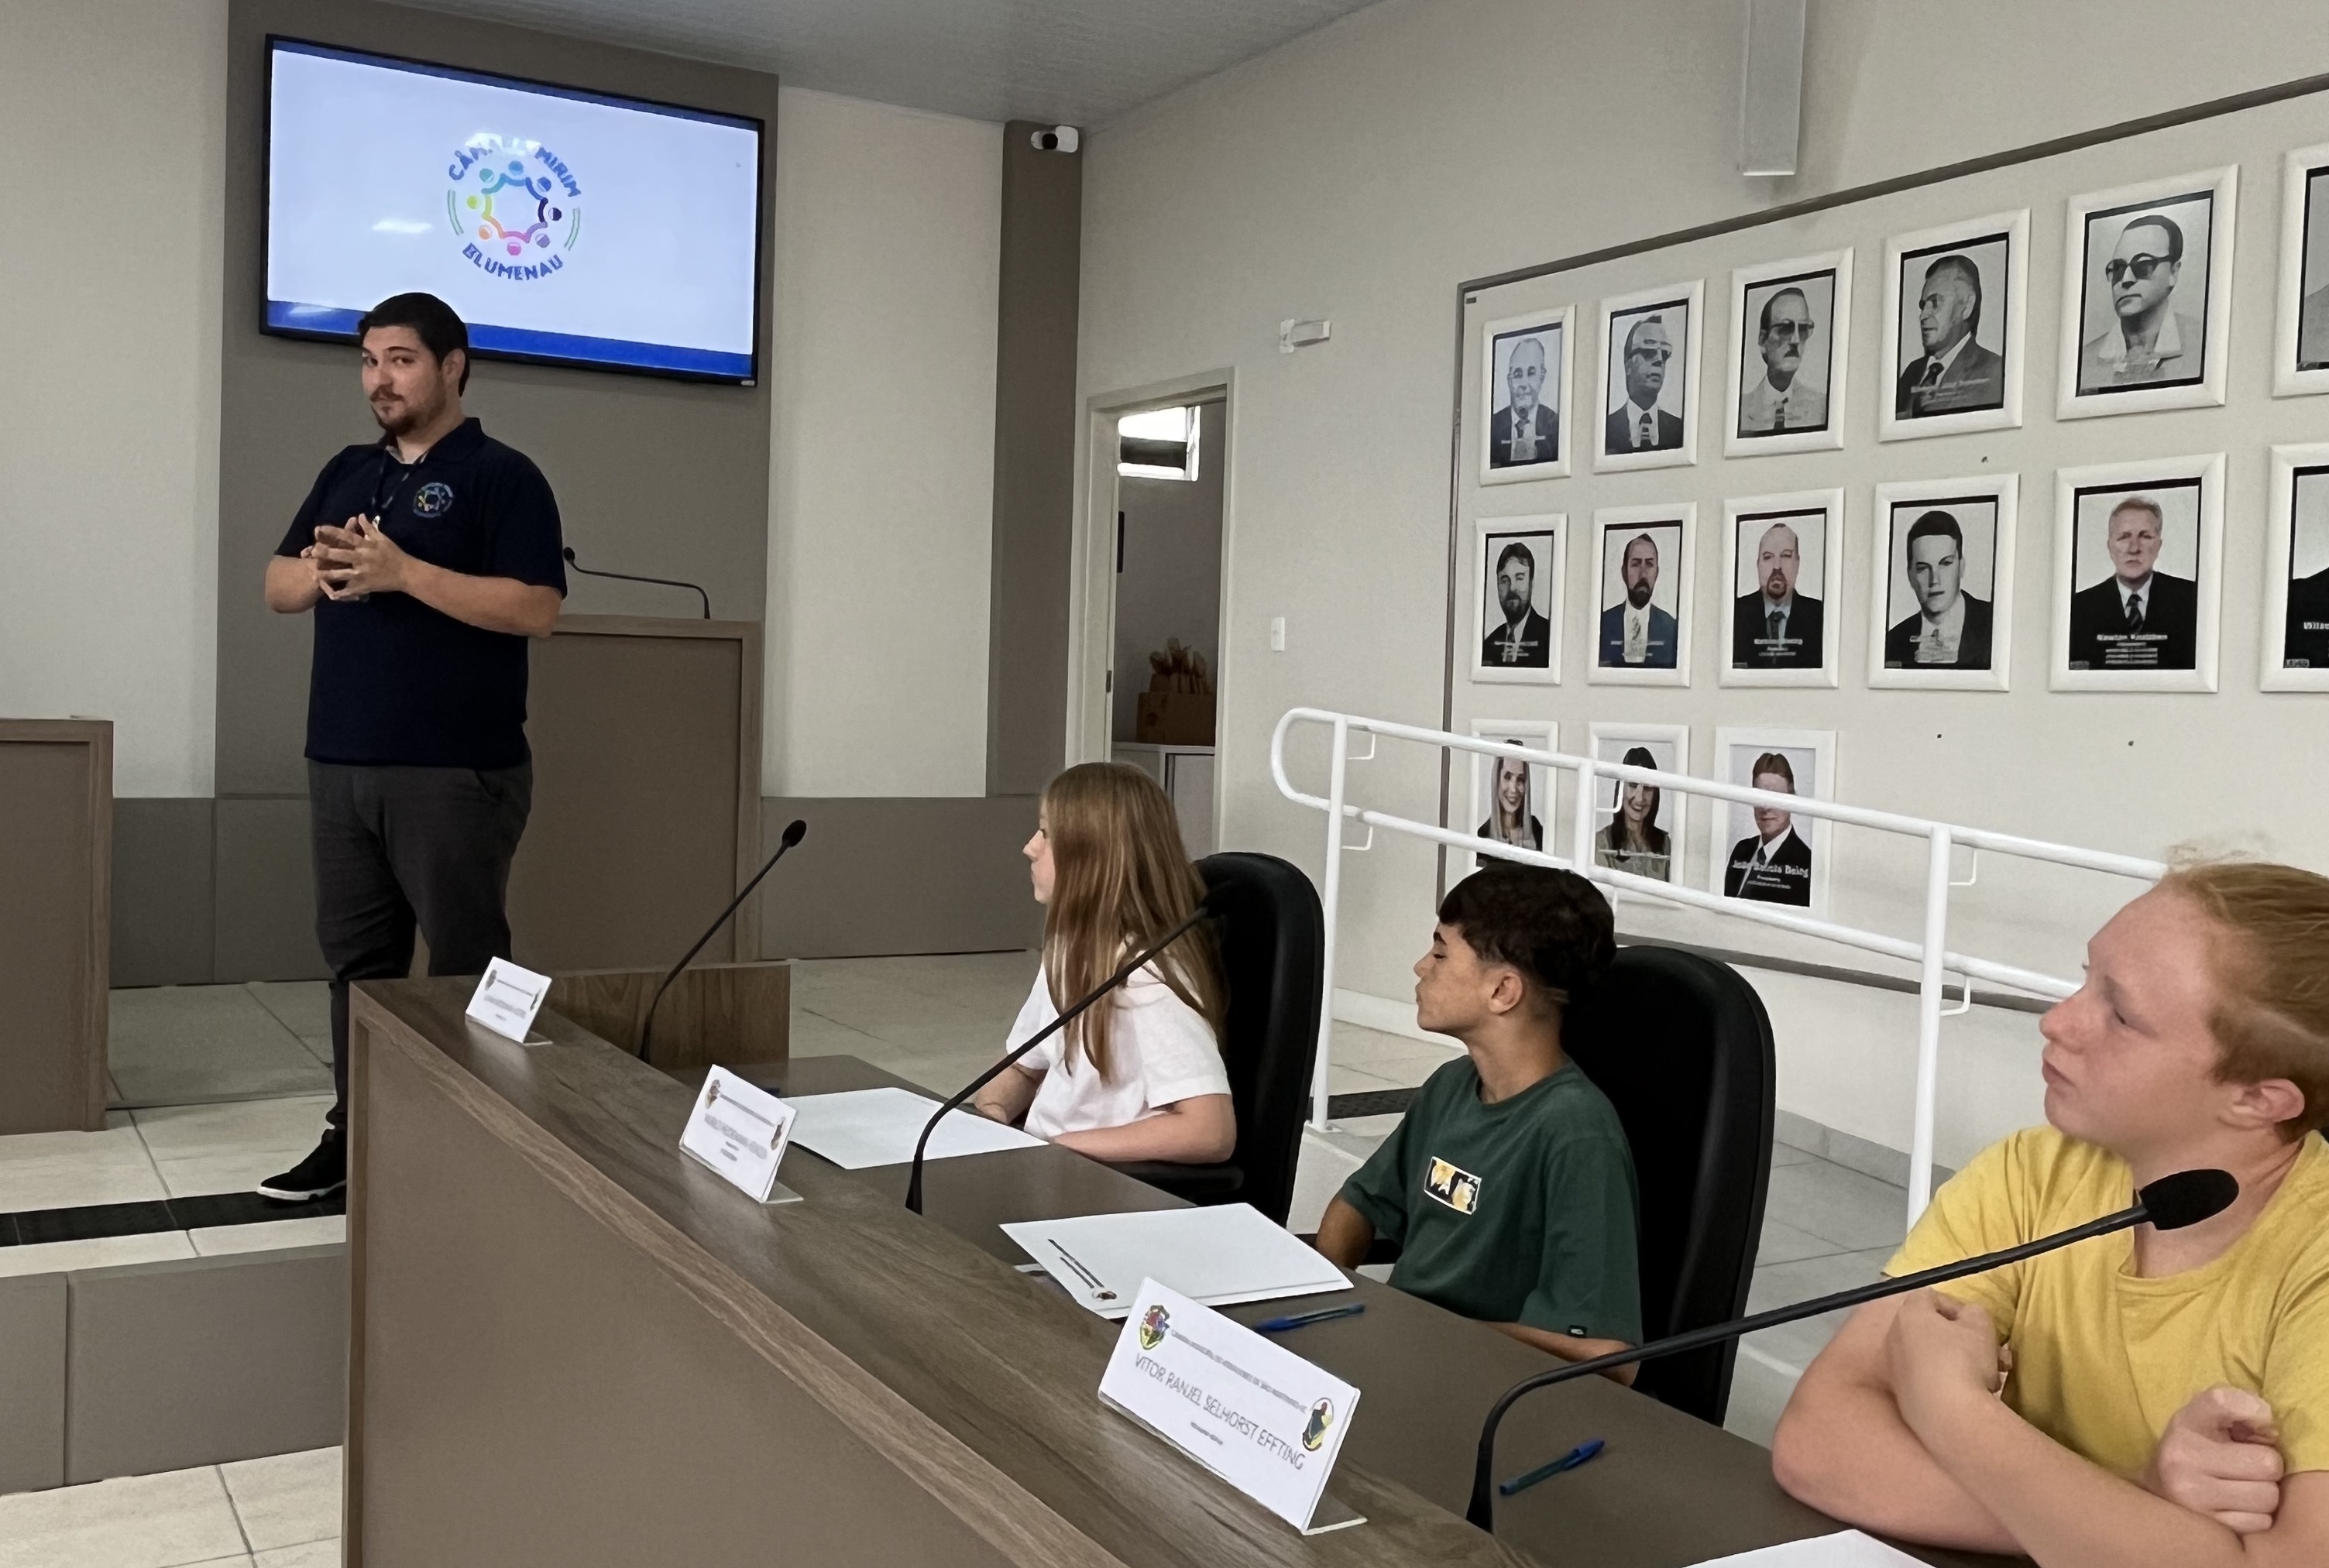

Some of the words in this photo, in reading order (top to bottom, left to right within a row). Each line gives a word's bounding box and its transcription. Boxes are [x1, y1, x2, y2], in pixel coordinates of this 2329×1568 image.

[534, 147, 582, 197] MIRIM
[462, 242, 563, 280] BLUMENAU
[1135, 1354, 1166, 1383] VITOR
[1165, 1371, 1203, 1407] RANJEL
[1202, 1395, 1259, 1441] SELHORST
[1257, 1429, 1306, 1470] EFFTING
